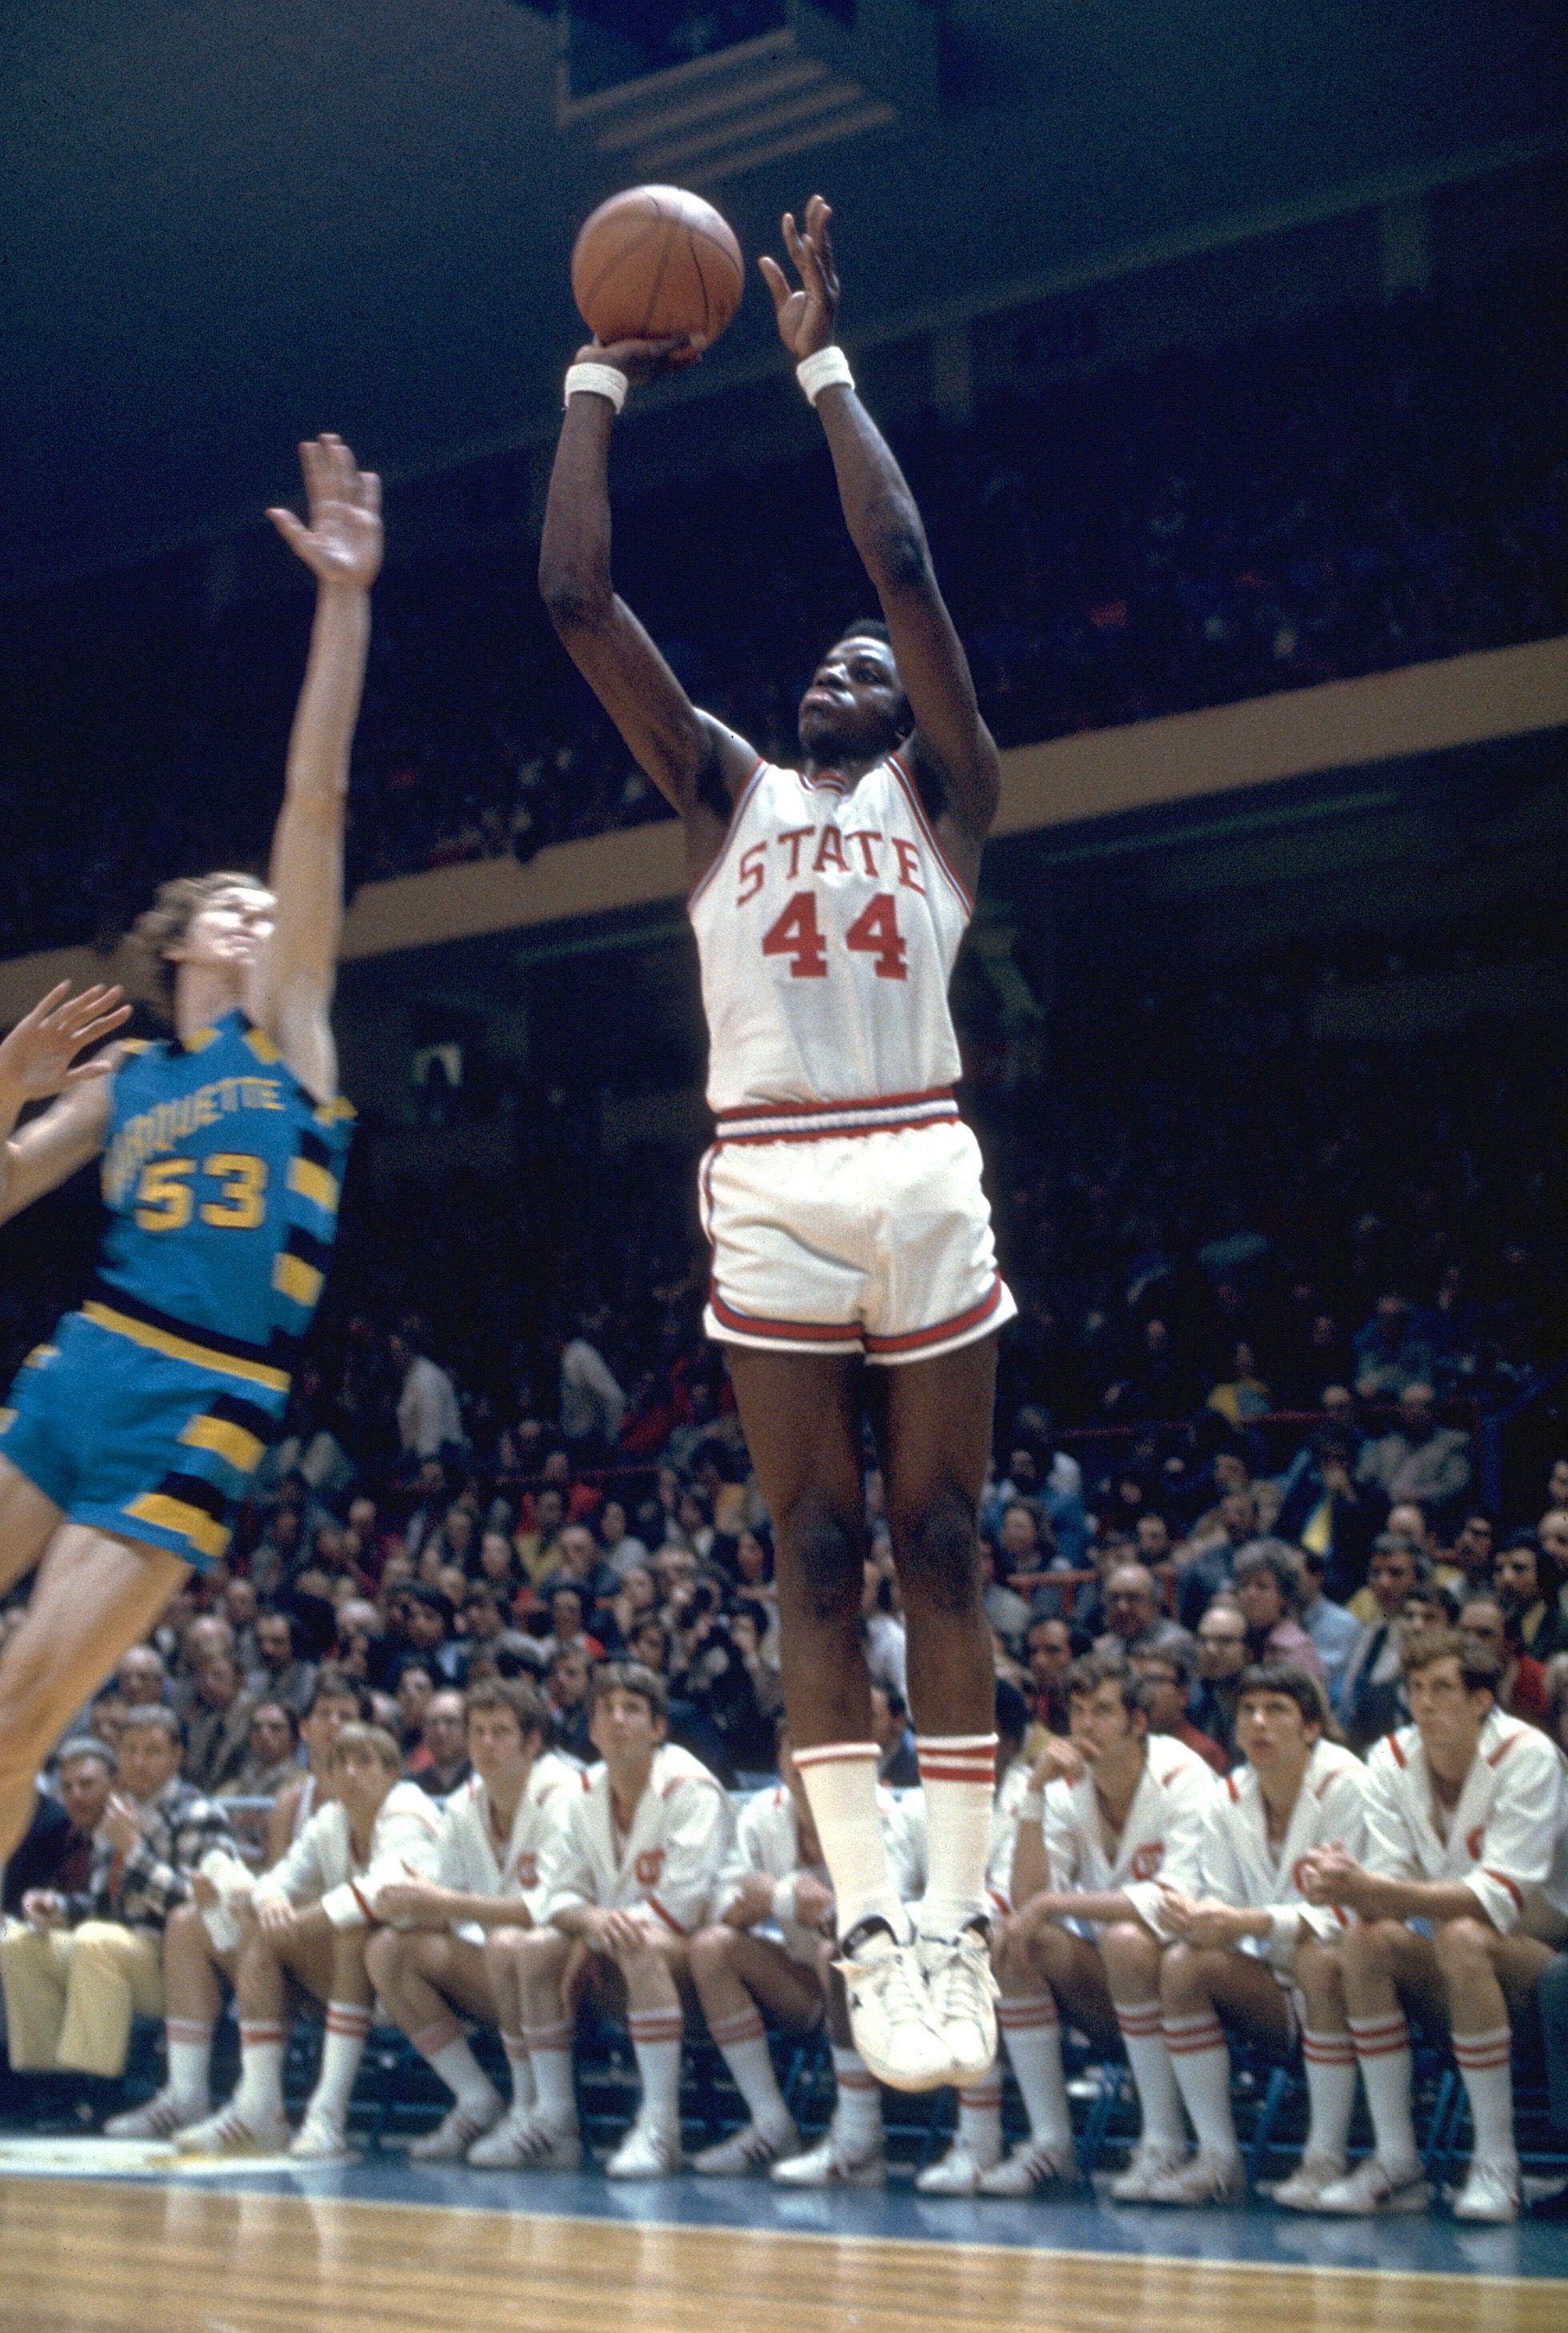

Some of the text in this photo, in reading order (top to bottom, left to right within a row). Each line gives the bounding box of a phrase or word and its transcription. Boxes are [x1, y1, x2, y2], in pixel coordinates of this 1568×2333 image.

[737, 825, 926, 907] STATE
[762, 890, 907, 981] 44
[101, 1076, 286, 1205] RQUETTE
[134, 1152, 269, 1233] 53
